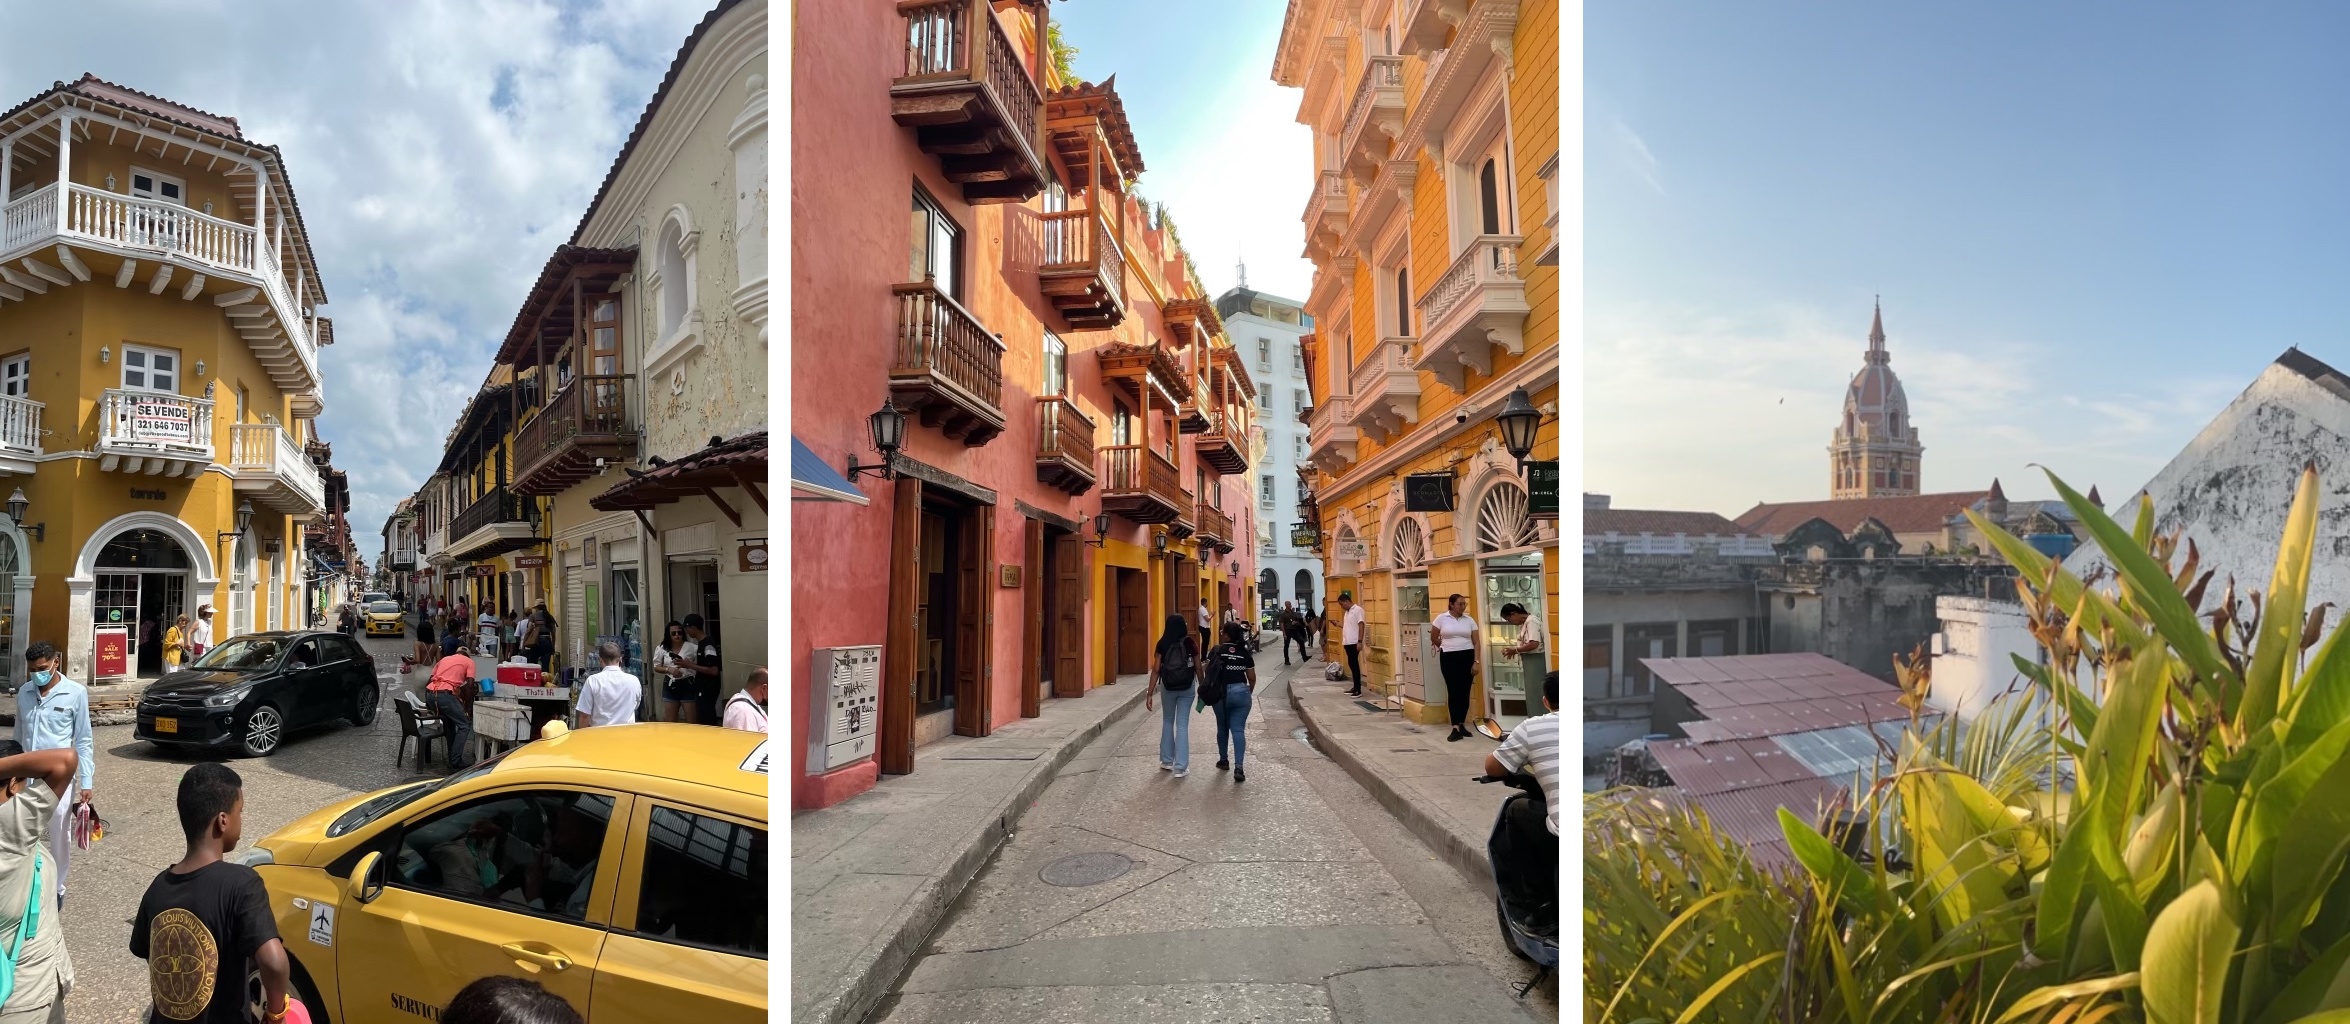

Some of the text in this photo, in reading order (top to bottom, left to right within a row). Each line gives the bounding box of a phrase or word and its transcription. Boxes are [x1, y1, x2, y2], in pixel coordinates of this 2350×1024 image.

[137, 405, 188, 418] SE VENDE
[137, 420, 188, 432] 321 646 7037
[162, 914, 184, 925] LOUIS
[198, 972, 215, 1004] LOUIS
[391, 992, 444, 1022] SERVICI
